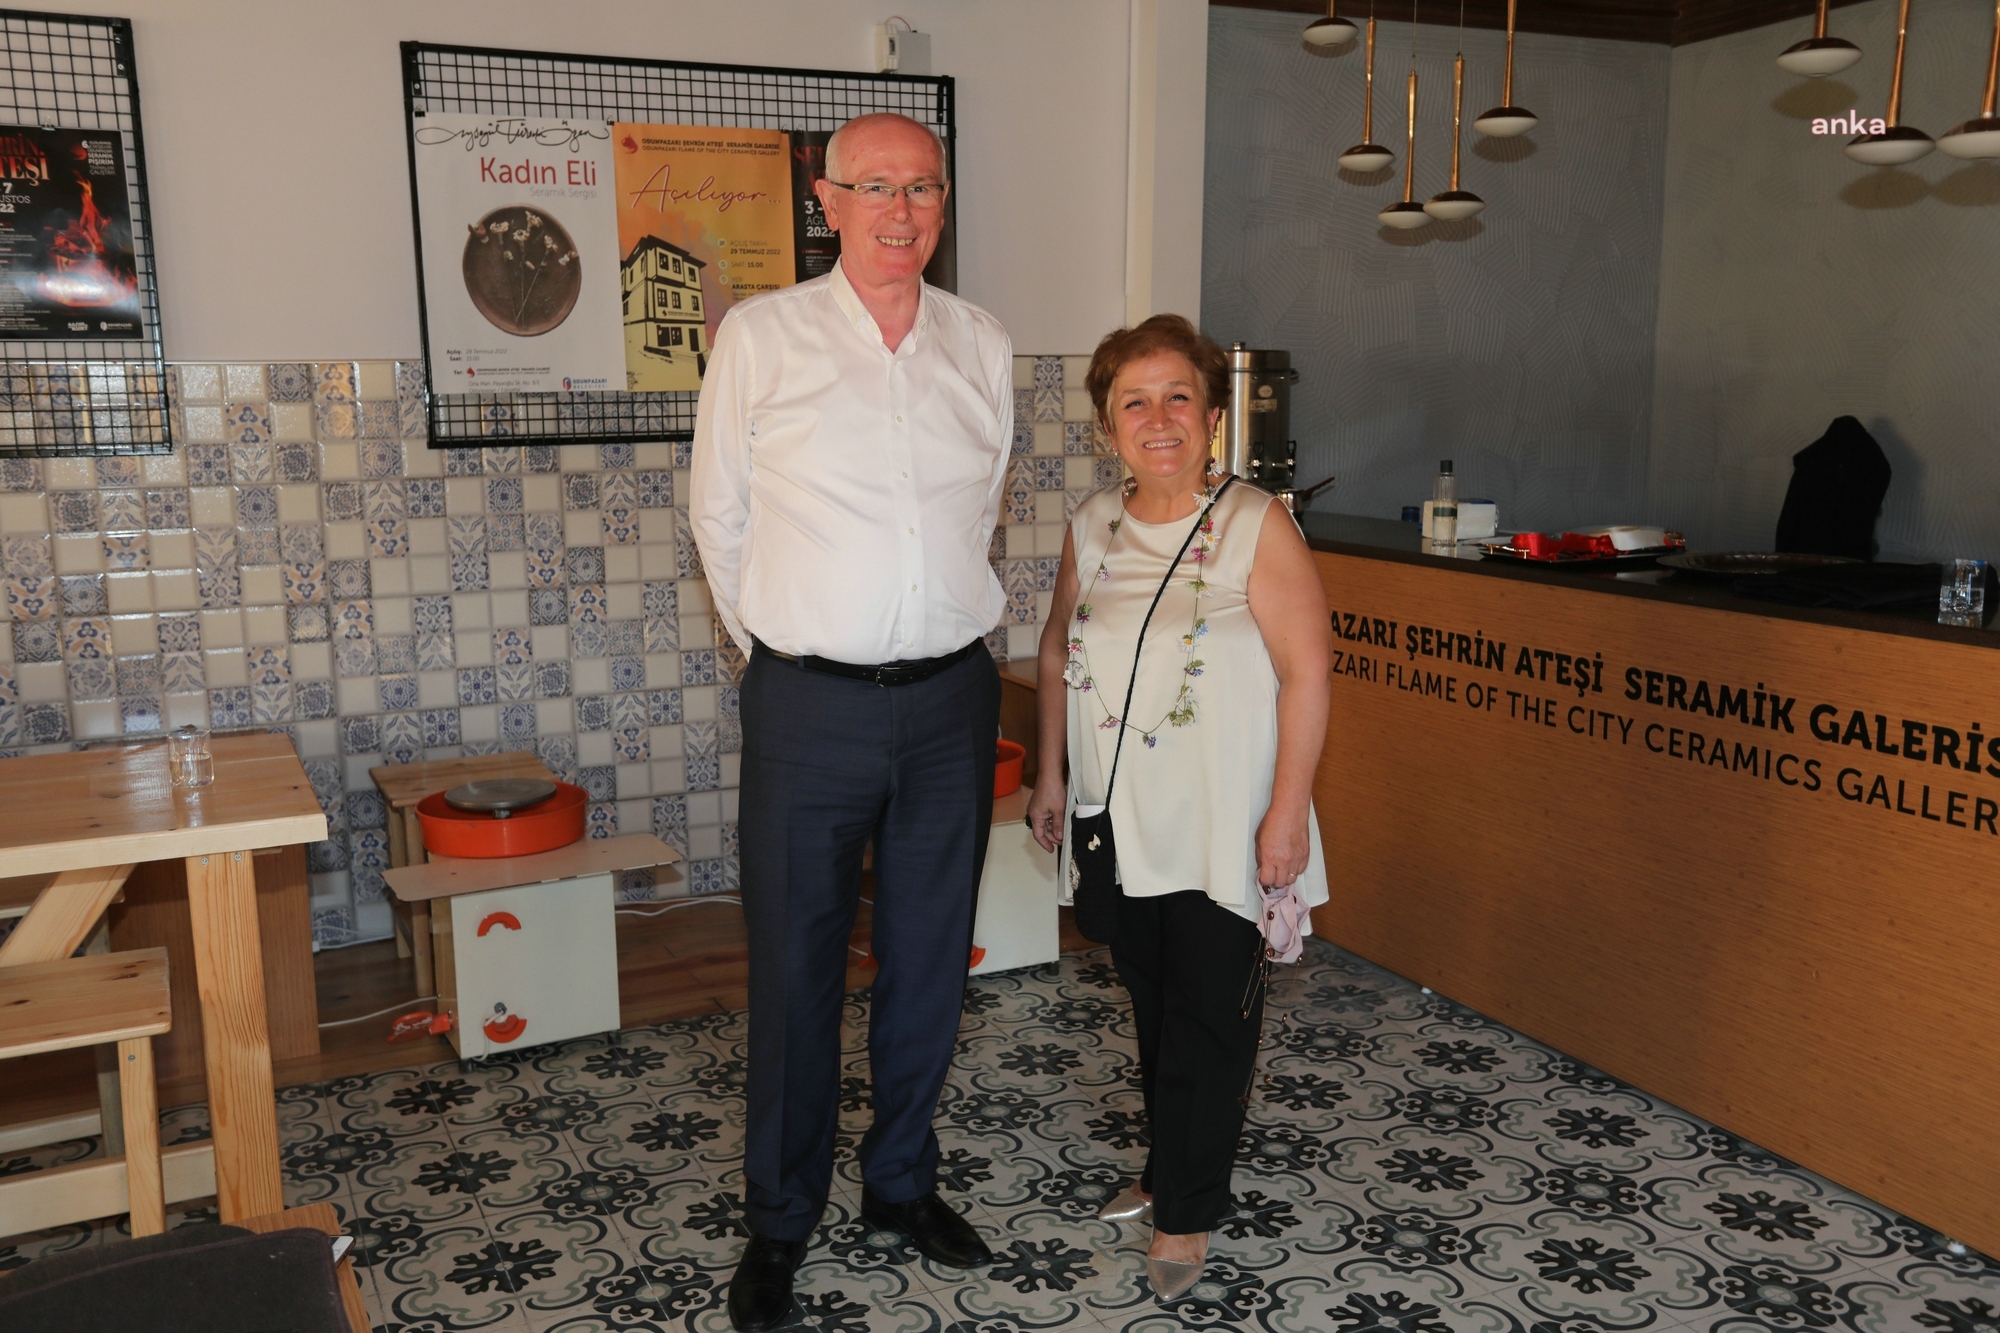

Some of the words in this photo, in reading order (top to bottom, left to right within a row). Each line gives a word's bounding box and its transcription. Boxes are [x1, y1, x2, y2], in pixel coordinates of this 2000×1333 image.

[480, 157, 556, 185] Kadın
[567, 160, 597, 186] Eli
[2, 182, 13, 194] 7
[530, 187, 566, 198] Seramik
[568, 187, 597, 200] Sergisi
[804, 201, 814, 214] 3
[1405, 625, 1506, 672] ŞEHRİN
[1514, 646, 1604, 697] ATEŞİ
[1624, 666, 1796, 734] SERAMİK
[1333, 650, 1377, 683] ZARI
[1386, 662, 1457, 703] FLAME
[1465, 682, 1498, 711] OF
[1506, 690, 1557, 728] THE
[1567, 705, 1634, 745] CITY
[1644, 723, 1822, 792] CERAMICS
[1836, 767, 1999, 836] GALLER
